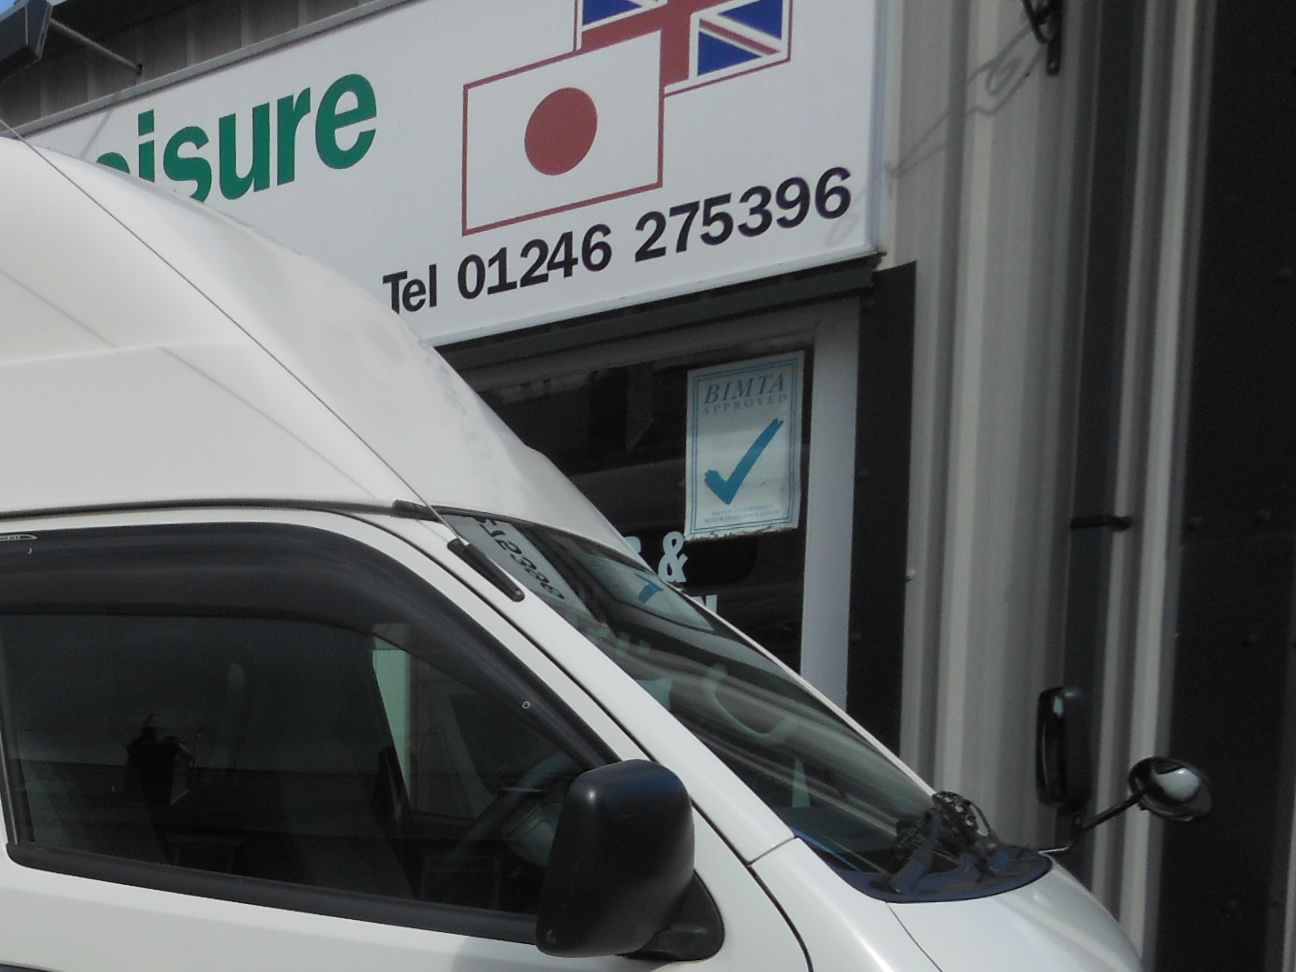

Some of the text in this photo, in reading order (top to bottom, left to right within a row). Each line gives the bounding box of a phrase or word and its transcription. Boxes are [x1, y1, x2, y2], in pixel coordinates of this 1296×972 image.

[382, 167, 851, 315] Tel 01246 275396
[705, 374, 785, 404] BIMTA
